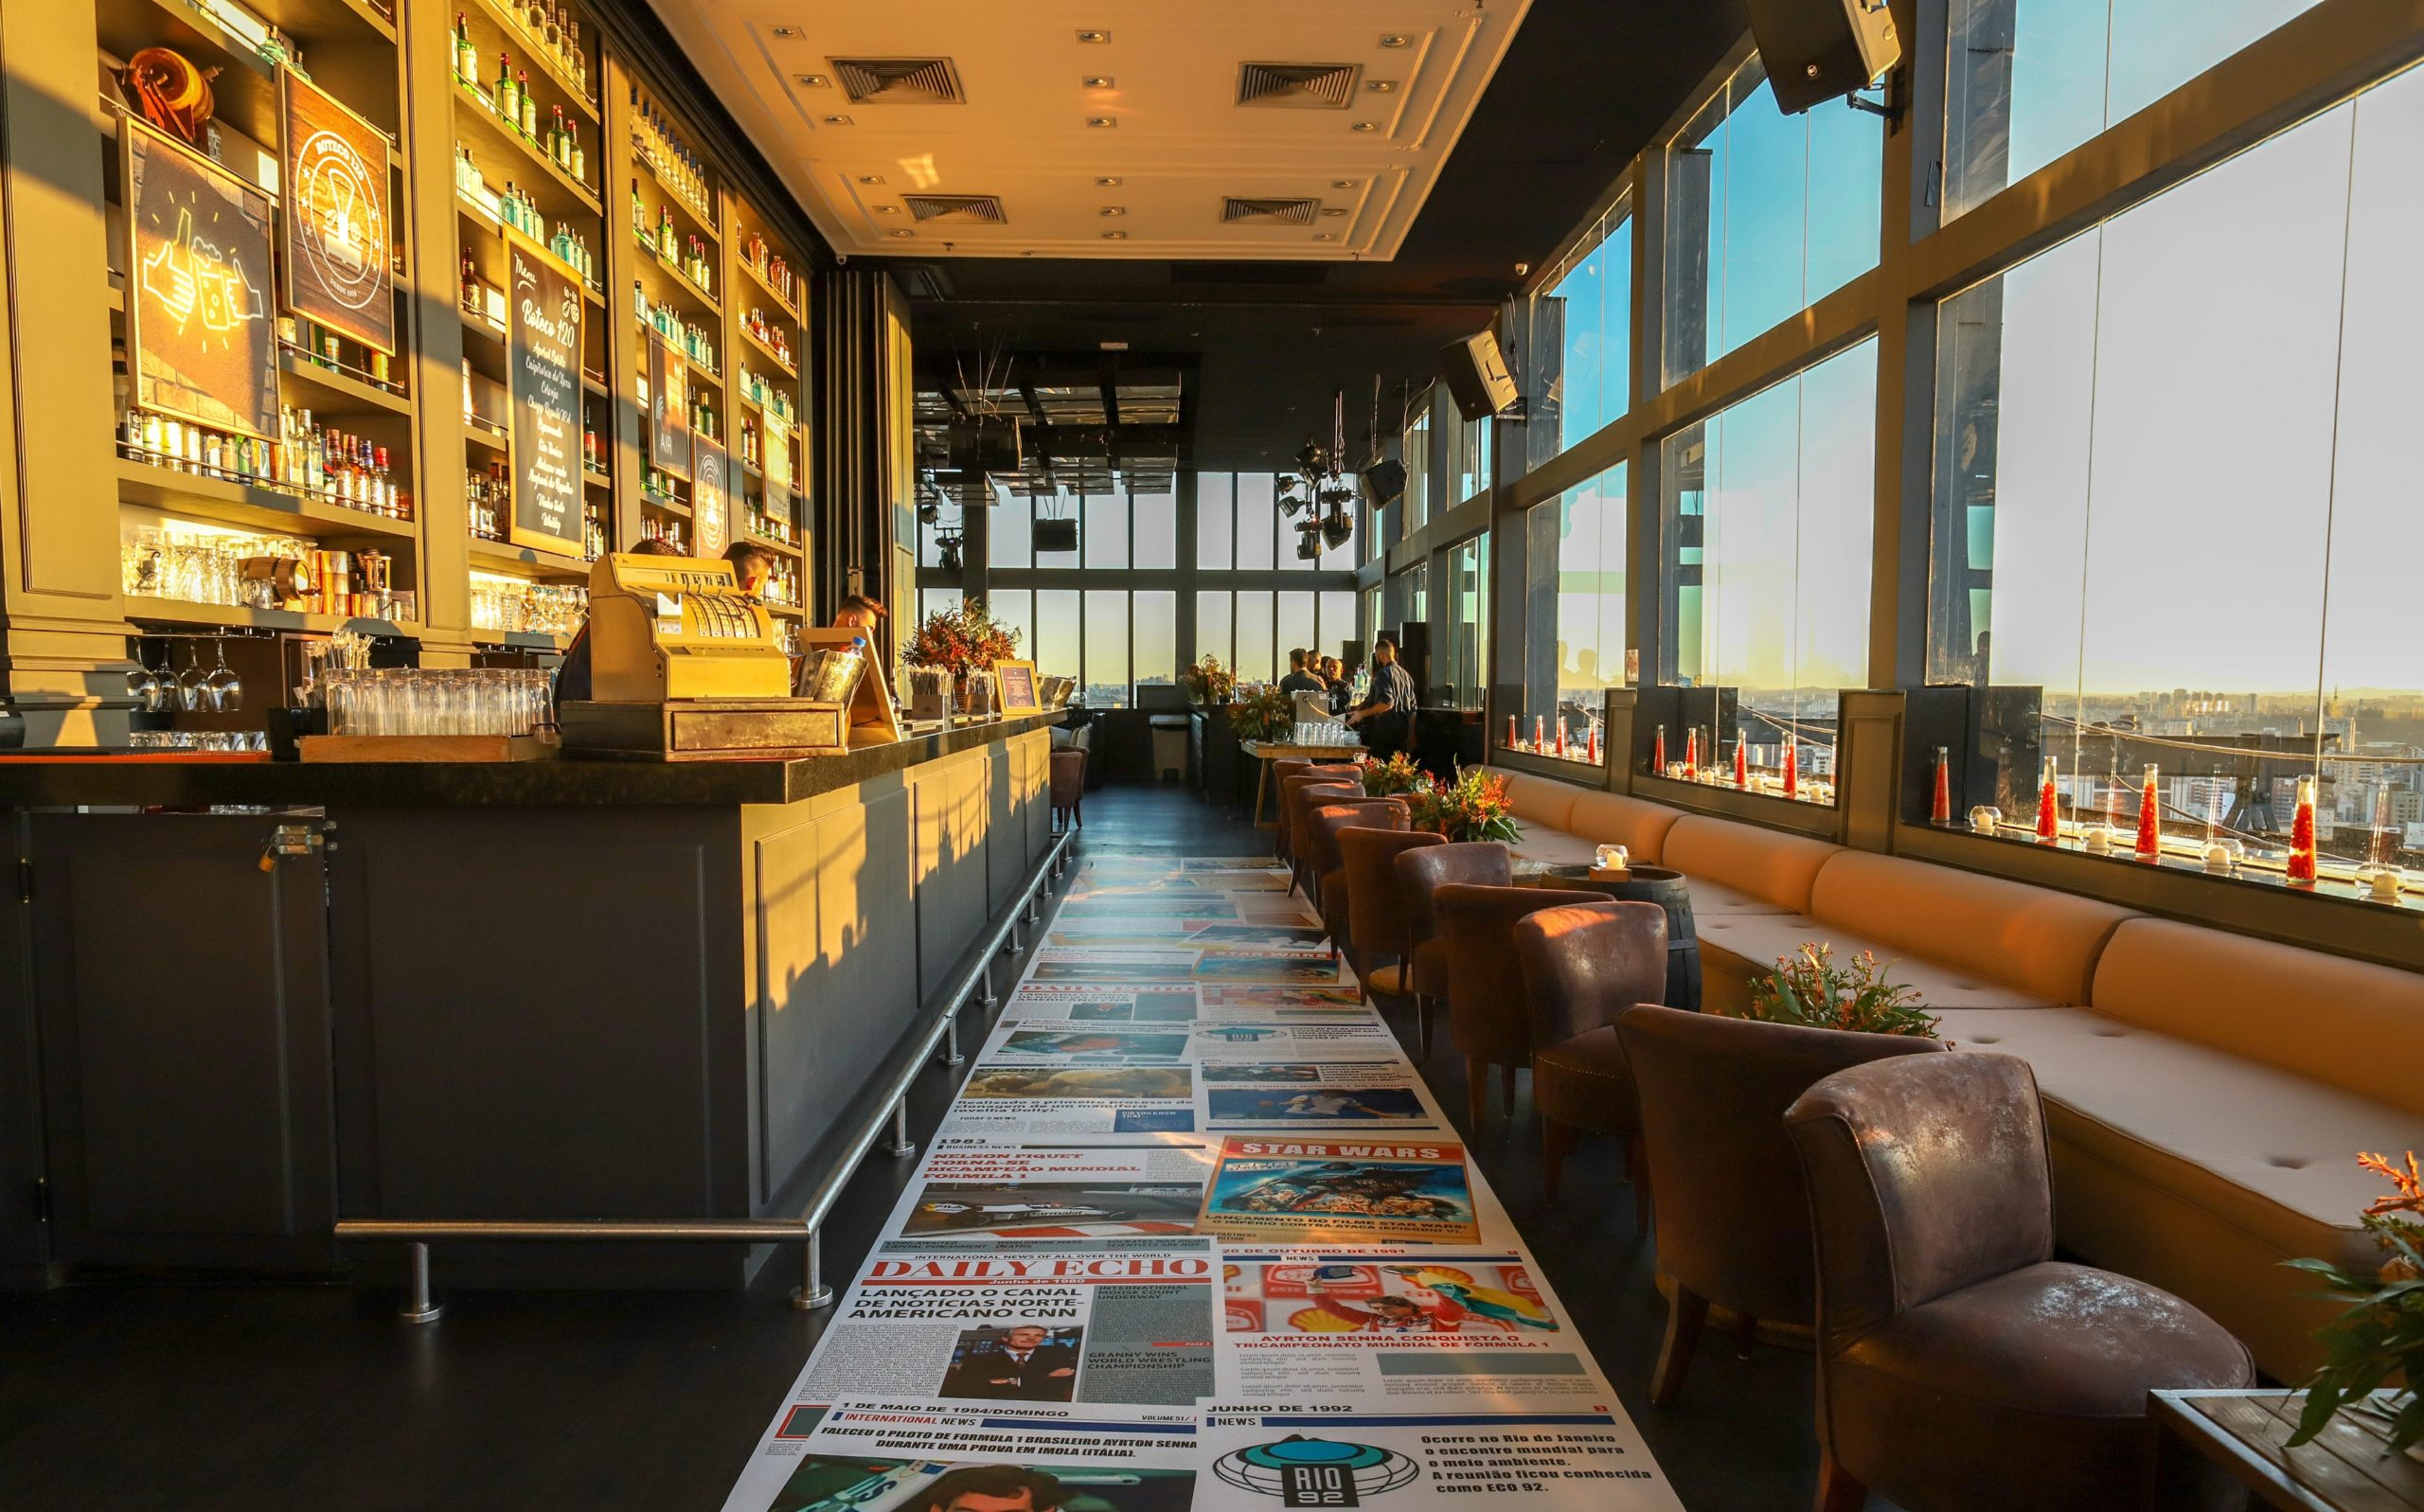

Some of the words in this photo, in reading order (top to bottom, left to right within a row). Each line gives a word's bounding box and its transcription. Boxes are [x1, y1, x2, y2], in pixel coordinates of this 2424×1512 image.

[315, 138, 349, 160] BOTECO
[515, 253, 537, 283] Menu
[522, 298, 556, 337] Boteco
[557, 319, 575, 348] 120
[661, 433, 672, 454] AIR
[1242, 1143, 1327, 1155] STAR
[1339, 1146, 1440, 1159] WARS
[867, 1261, 1040, 1277] DAILY
[1052, 1259, 1209, 1276] ECHO
[860, 1290, 975, 1299] LANÇADO
[890, 1298, 995, 1307] NOTÍCIAS
[847, 1309, 1013, 1318] AMERICANO
[1020, 1308, 1078, 1317] CNN
[845, 1414, 937, 1424] INTERNATIONAL
[941, 1417, 977, 1426] NEWS
[953, 1407, 1069, 1417] 1994/DOMINGO
[820, 1427, 874, 1436] FALECEU
[887, 1431, 933, 1439] PILOTO
[953, 1433, 1013, 1442] FORMULA
[1025, 1436, 1100, 1446] BRASILEIRO
[875, 1440, 936, 1450] DURANTE
[1082, 1448, 1136, 1457] (ITÁLIA).
[1293, 1468, 1343, 1490] RIO
[1447, 1470, 1512, 1479] reunião
[1563, 1469, 1652, 1478] conhecida
[1488, 1484, 1518, 1492] ECO
[1521, 1483, 1549, 1491] 92.
[1298, 1492, 1345, 1503] 92
